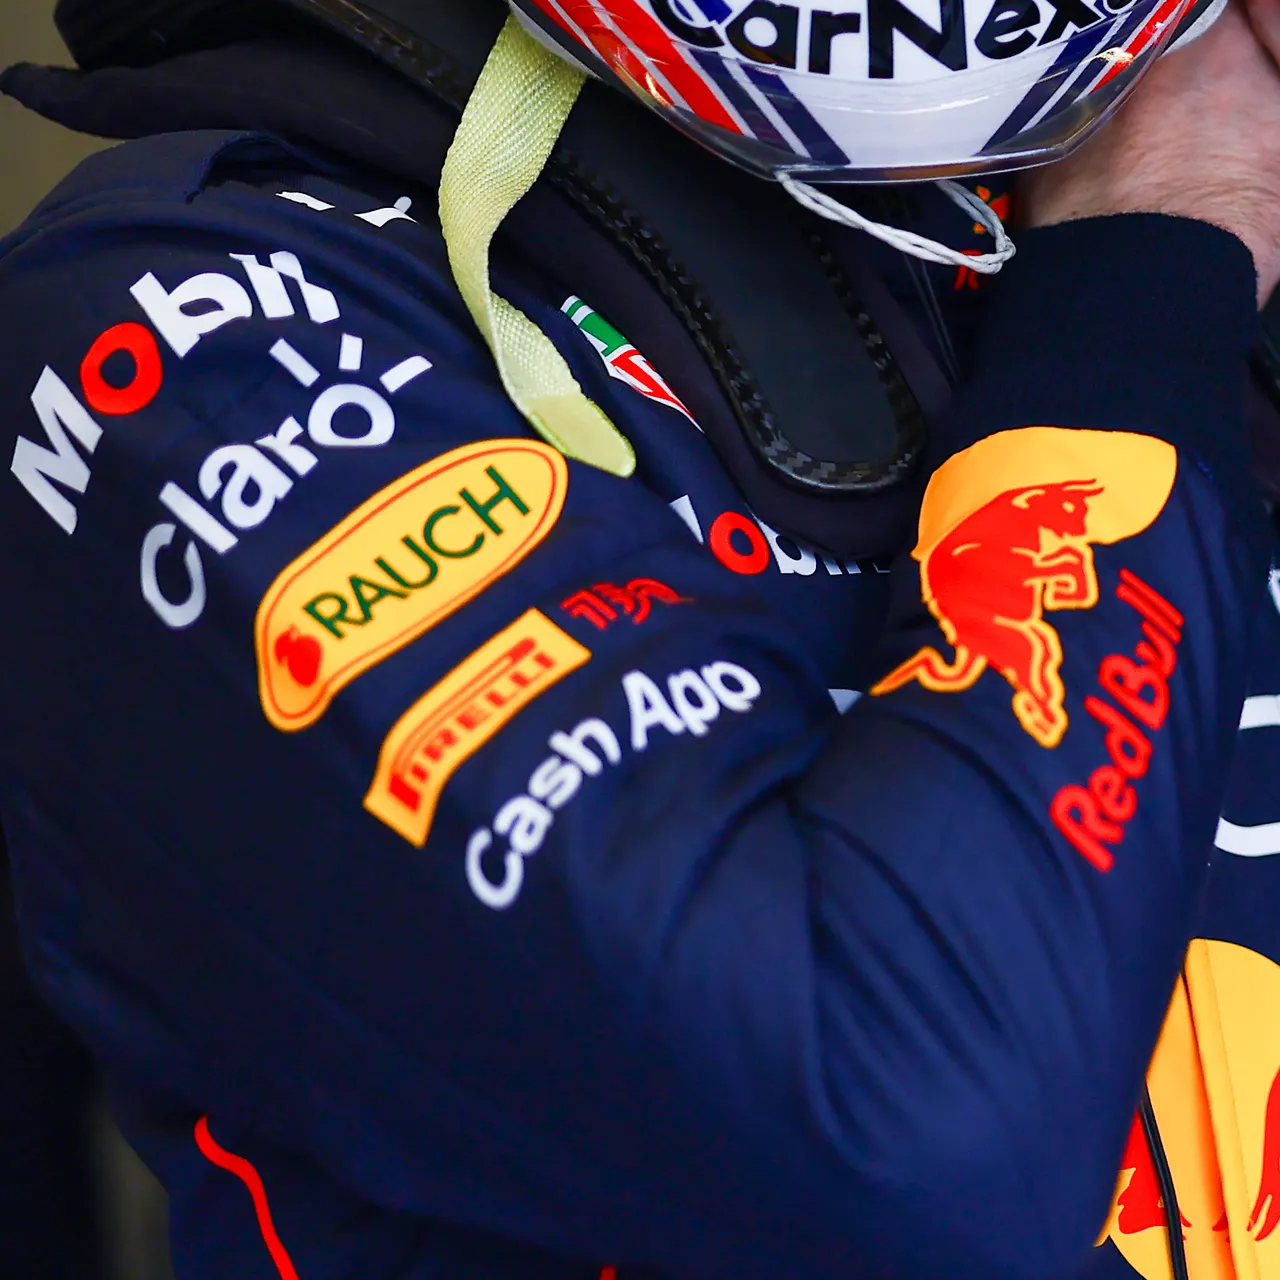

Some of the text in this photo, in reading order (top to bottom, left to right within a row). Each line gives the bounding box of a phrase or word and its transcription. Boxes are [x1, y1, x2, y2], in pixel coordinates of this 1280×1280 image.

[140, 384, 396, 628] Claro
[302, 464, 531, 640] RAUCH
[387, 636, 558, 814] PIRELLI
[465, 660, 762, 910] Cash App
[1049, 567, 1185, 874] Red Bull
